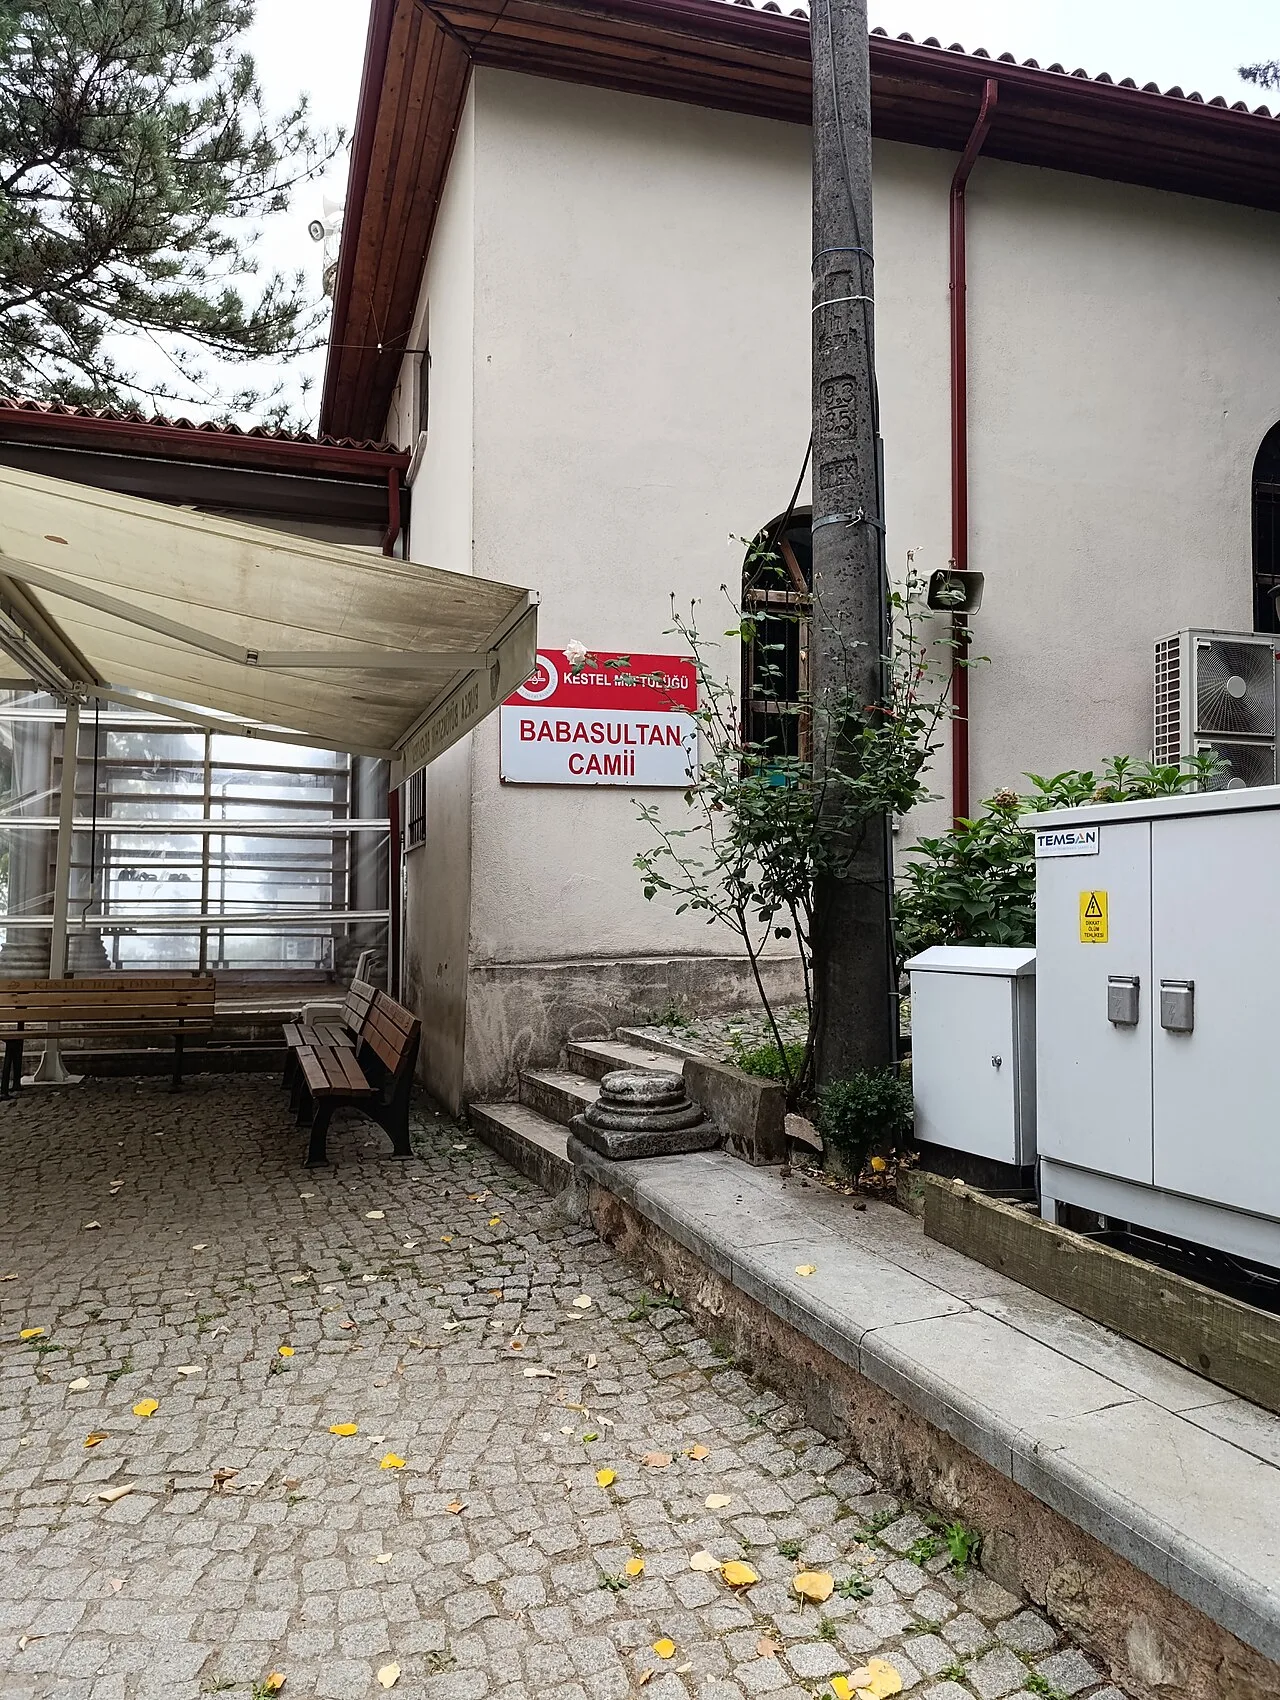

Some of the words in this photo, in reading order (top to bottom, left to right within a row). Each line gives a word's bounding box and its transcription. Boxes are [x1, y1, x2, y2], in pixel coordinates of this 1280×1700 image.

[563, 672, 612, 687] KESTEL
[520, 719, 682, 747] BABASULTAN
[568, 749, 635, 776] CAMİİ
[1037, 831, 1096, 847] TEMSAN
